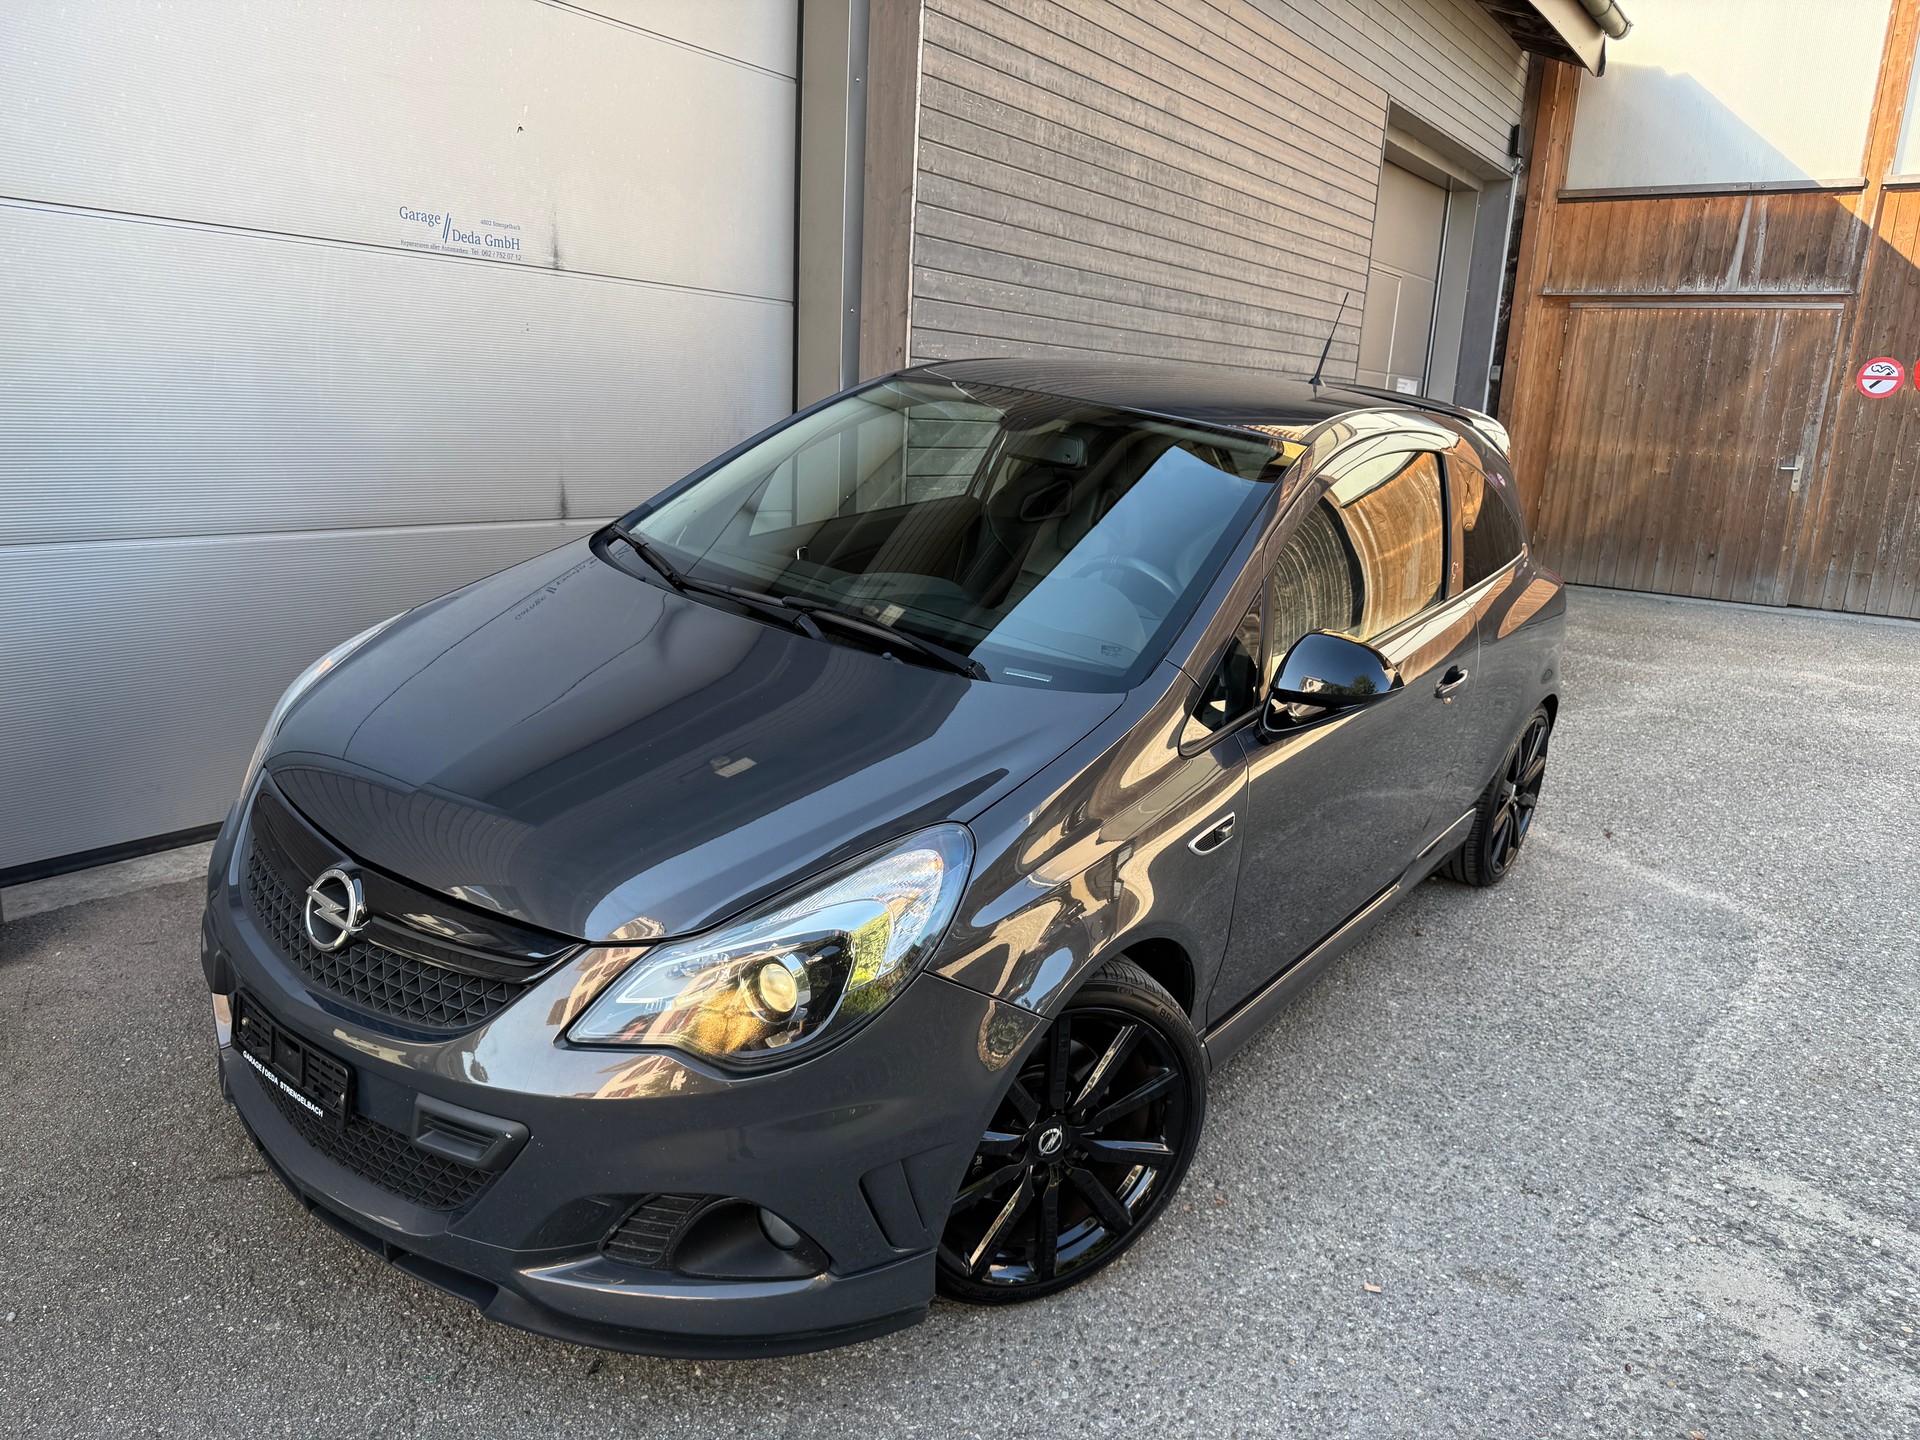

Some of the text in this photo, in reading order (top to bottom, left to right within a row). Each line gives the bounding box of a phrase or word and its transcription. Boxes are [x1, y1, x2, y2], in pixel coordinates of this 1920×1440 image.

[399, 206, 441, 228] Garage
[452, 229, 520, 251] Deda GmbH
[496, 251, 506, 259] 752
[279, 1081, 324, 1118] STRENGELBACH
